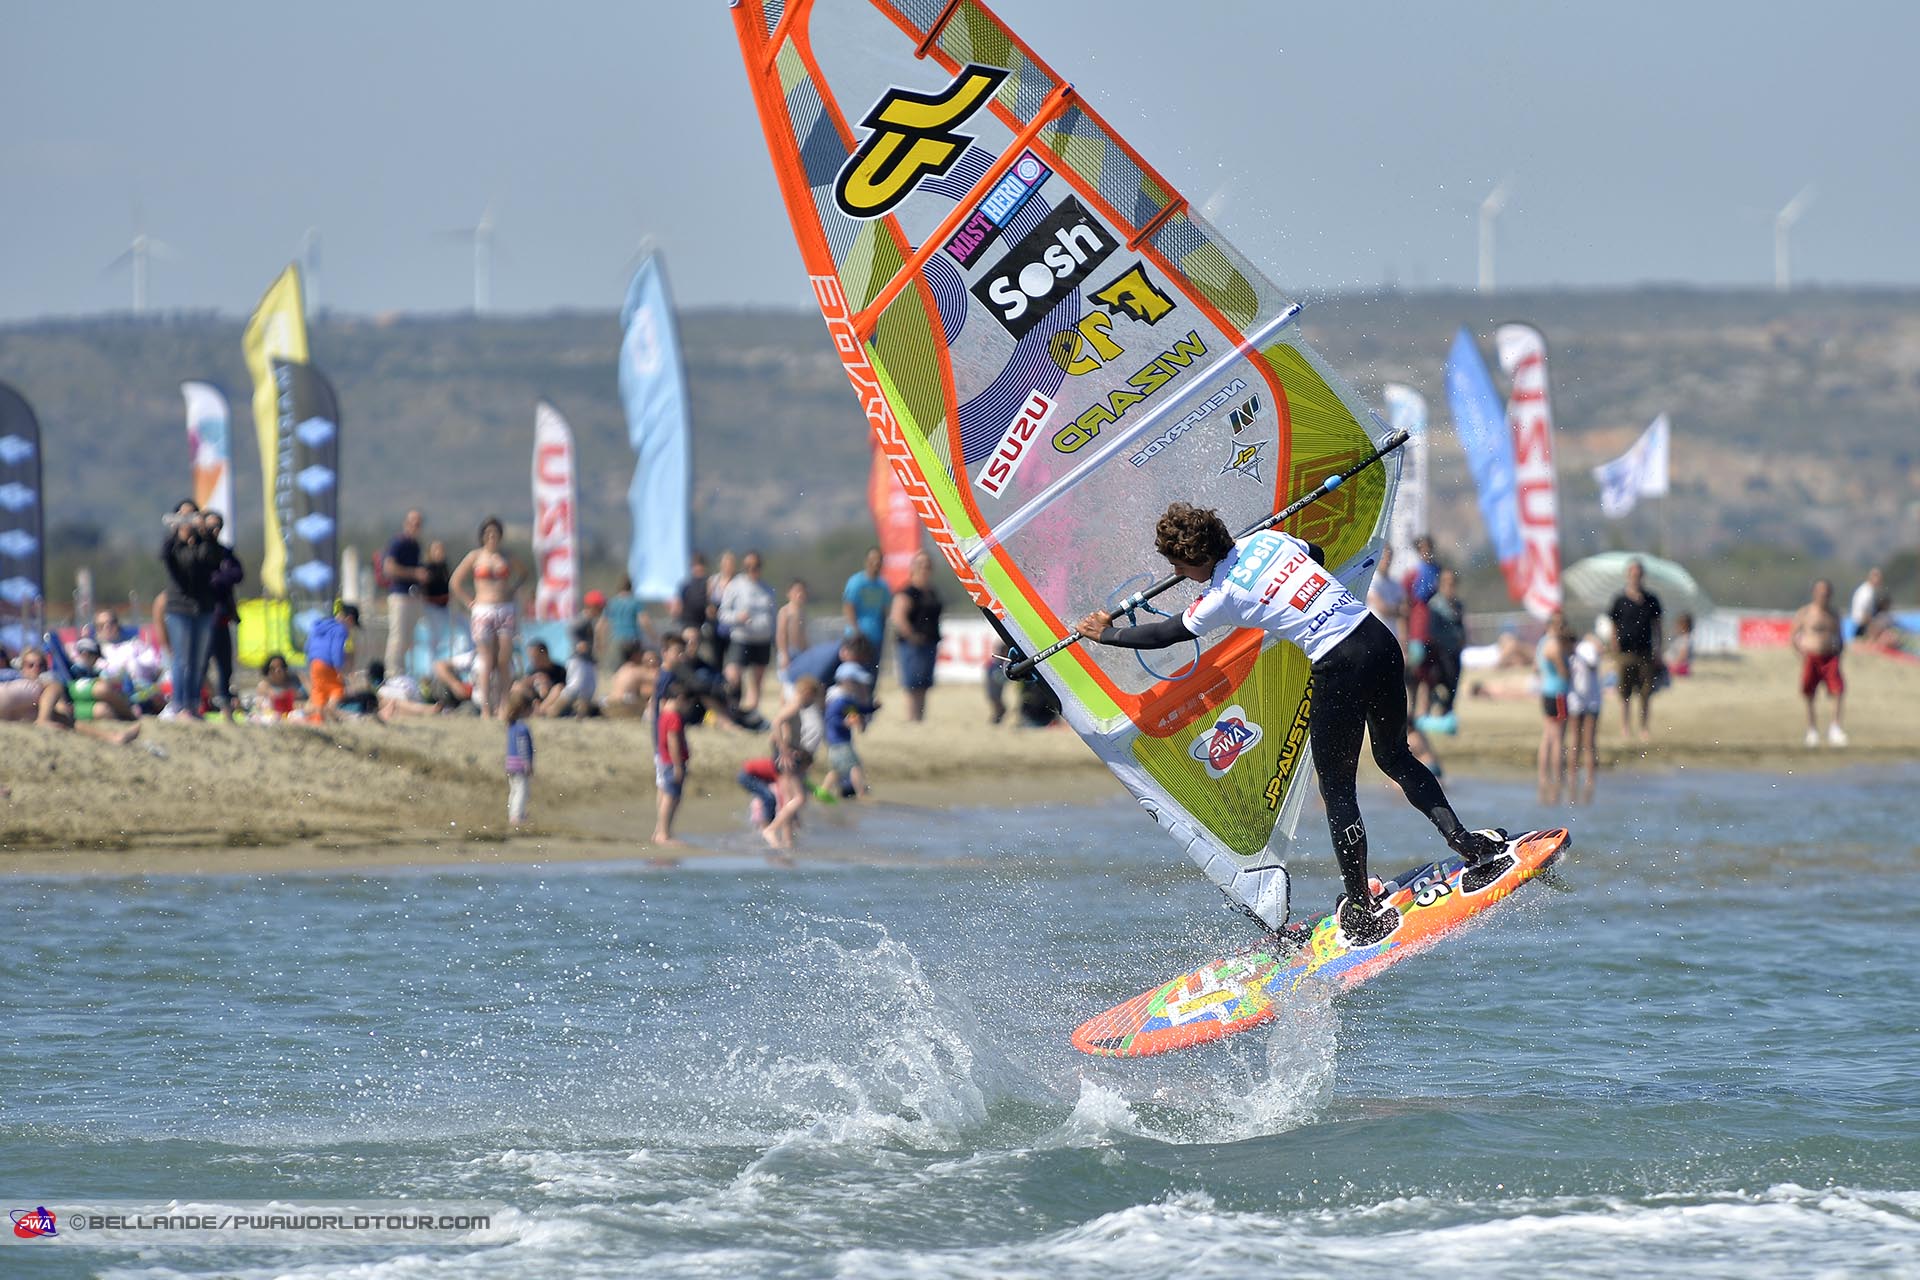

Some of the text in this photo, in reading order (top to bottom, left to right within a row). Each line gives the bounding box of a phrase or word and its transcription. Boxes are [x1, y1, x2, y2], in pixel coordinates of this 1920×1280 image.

[947, 211, 993, 263] MAST
[981, 174, 1027, 223] HERO
[988, 224, 1104, 321] Sosh
[981, 395, 1049, 493] ISUZU
[1232, 446, 1257, 469] JP
[1259, 552, 1308, 605] ISUZU
[1295, 577, 1321, 603] RMC
[1033, 632, 1081, 663] NEILPRY
[1210, 726, 1246, 762] PWA
